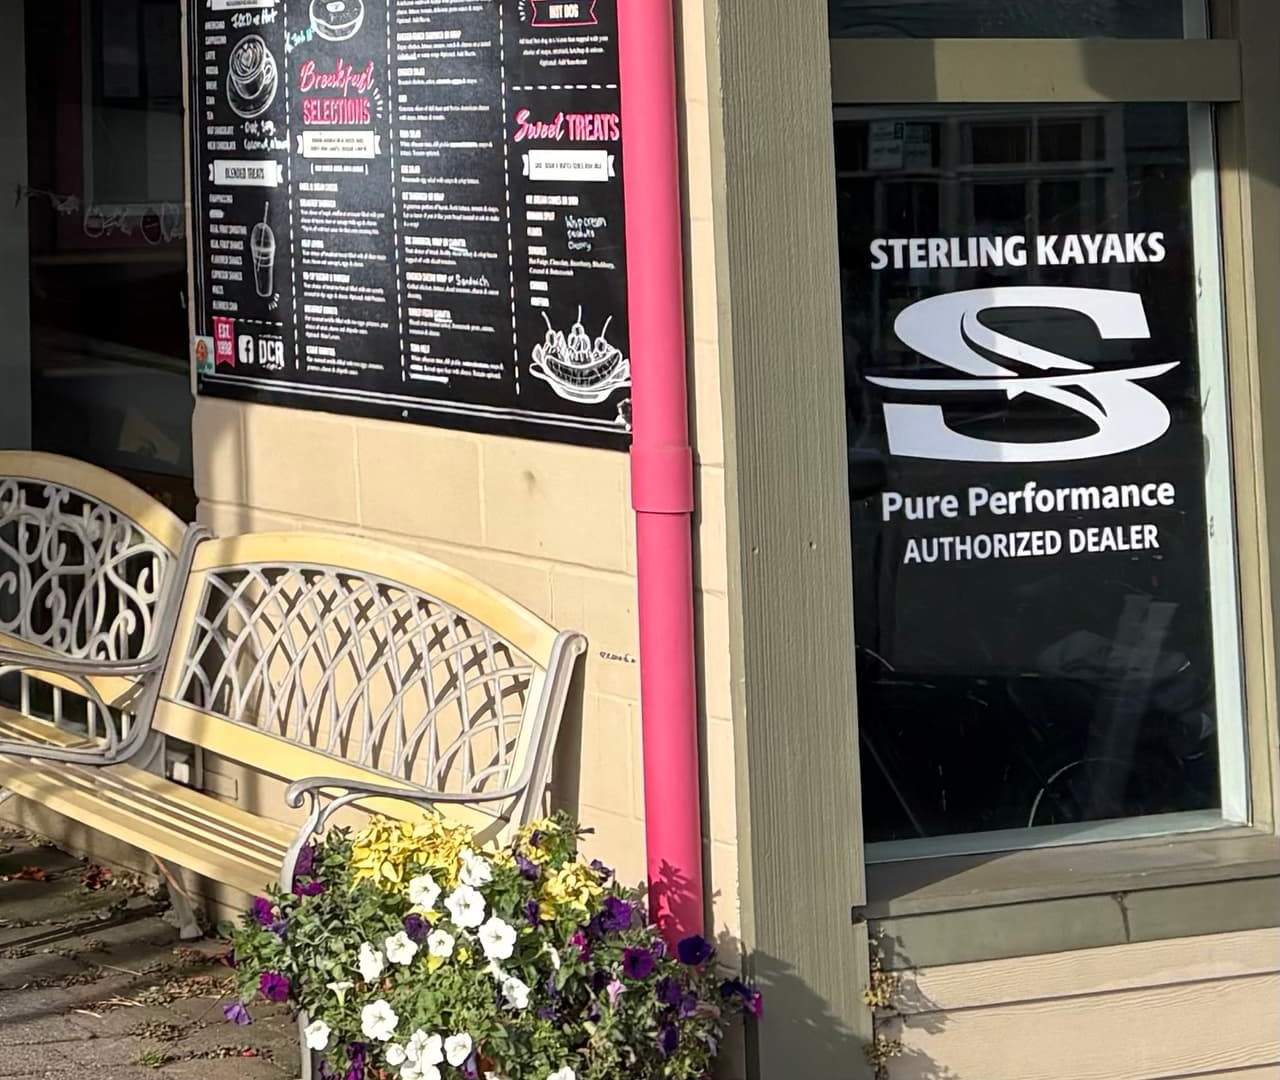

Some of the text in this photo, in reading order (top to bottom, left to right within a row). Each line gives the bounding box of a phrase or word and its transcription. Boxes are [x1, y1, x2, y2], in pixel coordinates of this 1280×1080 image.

[549, 4, 579, 19] HOT DOG
[300, 58, 375, 96] Breakfast
[303, 99, 371, 125] SELECTIONS
[514, 108, 620, 142] Sweet TREATS
[870, 230, 1166, 270] STERLING KAYAKS
[882, 481, 1175, 522] Pure Performance
[903, 524, 1159, 565] AUTHORIZED DEALER
